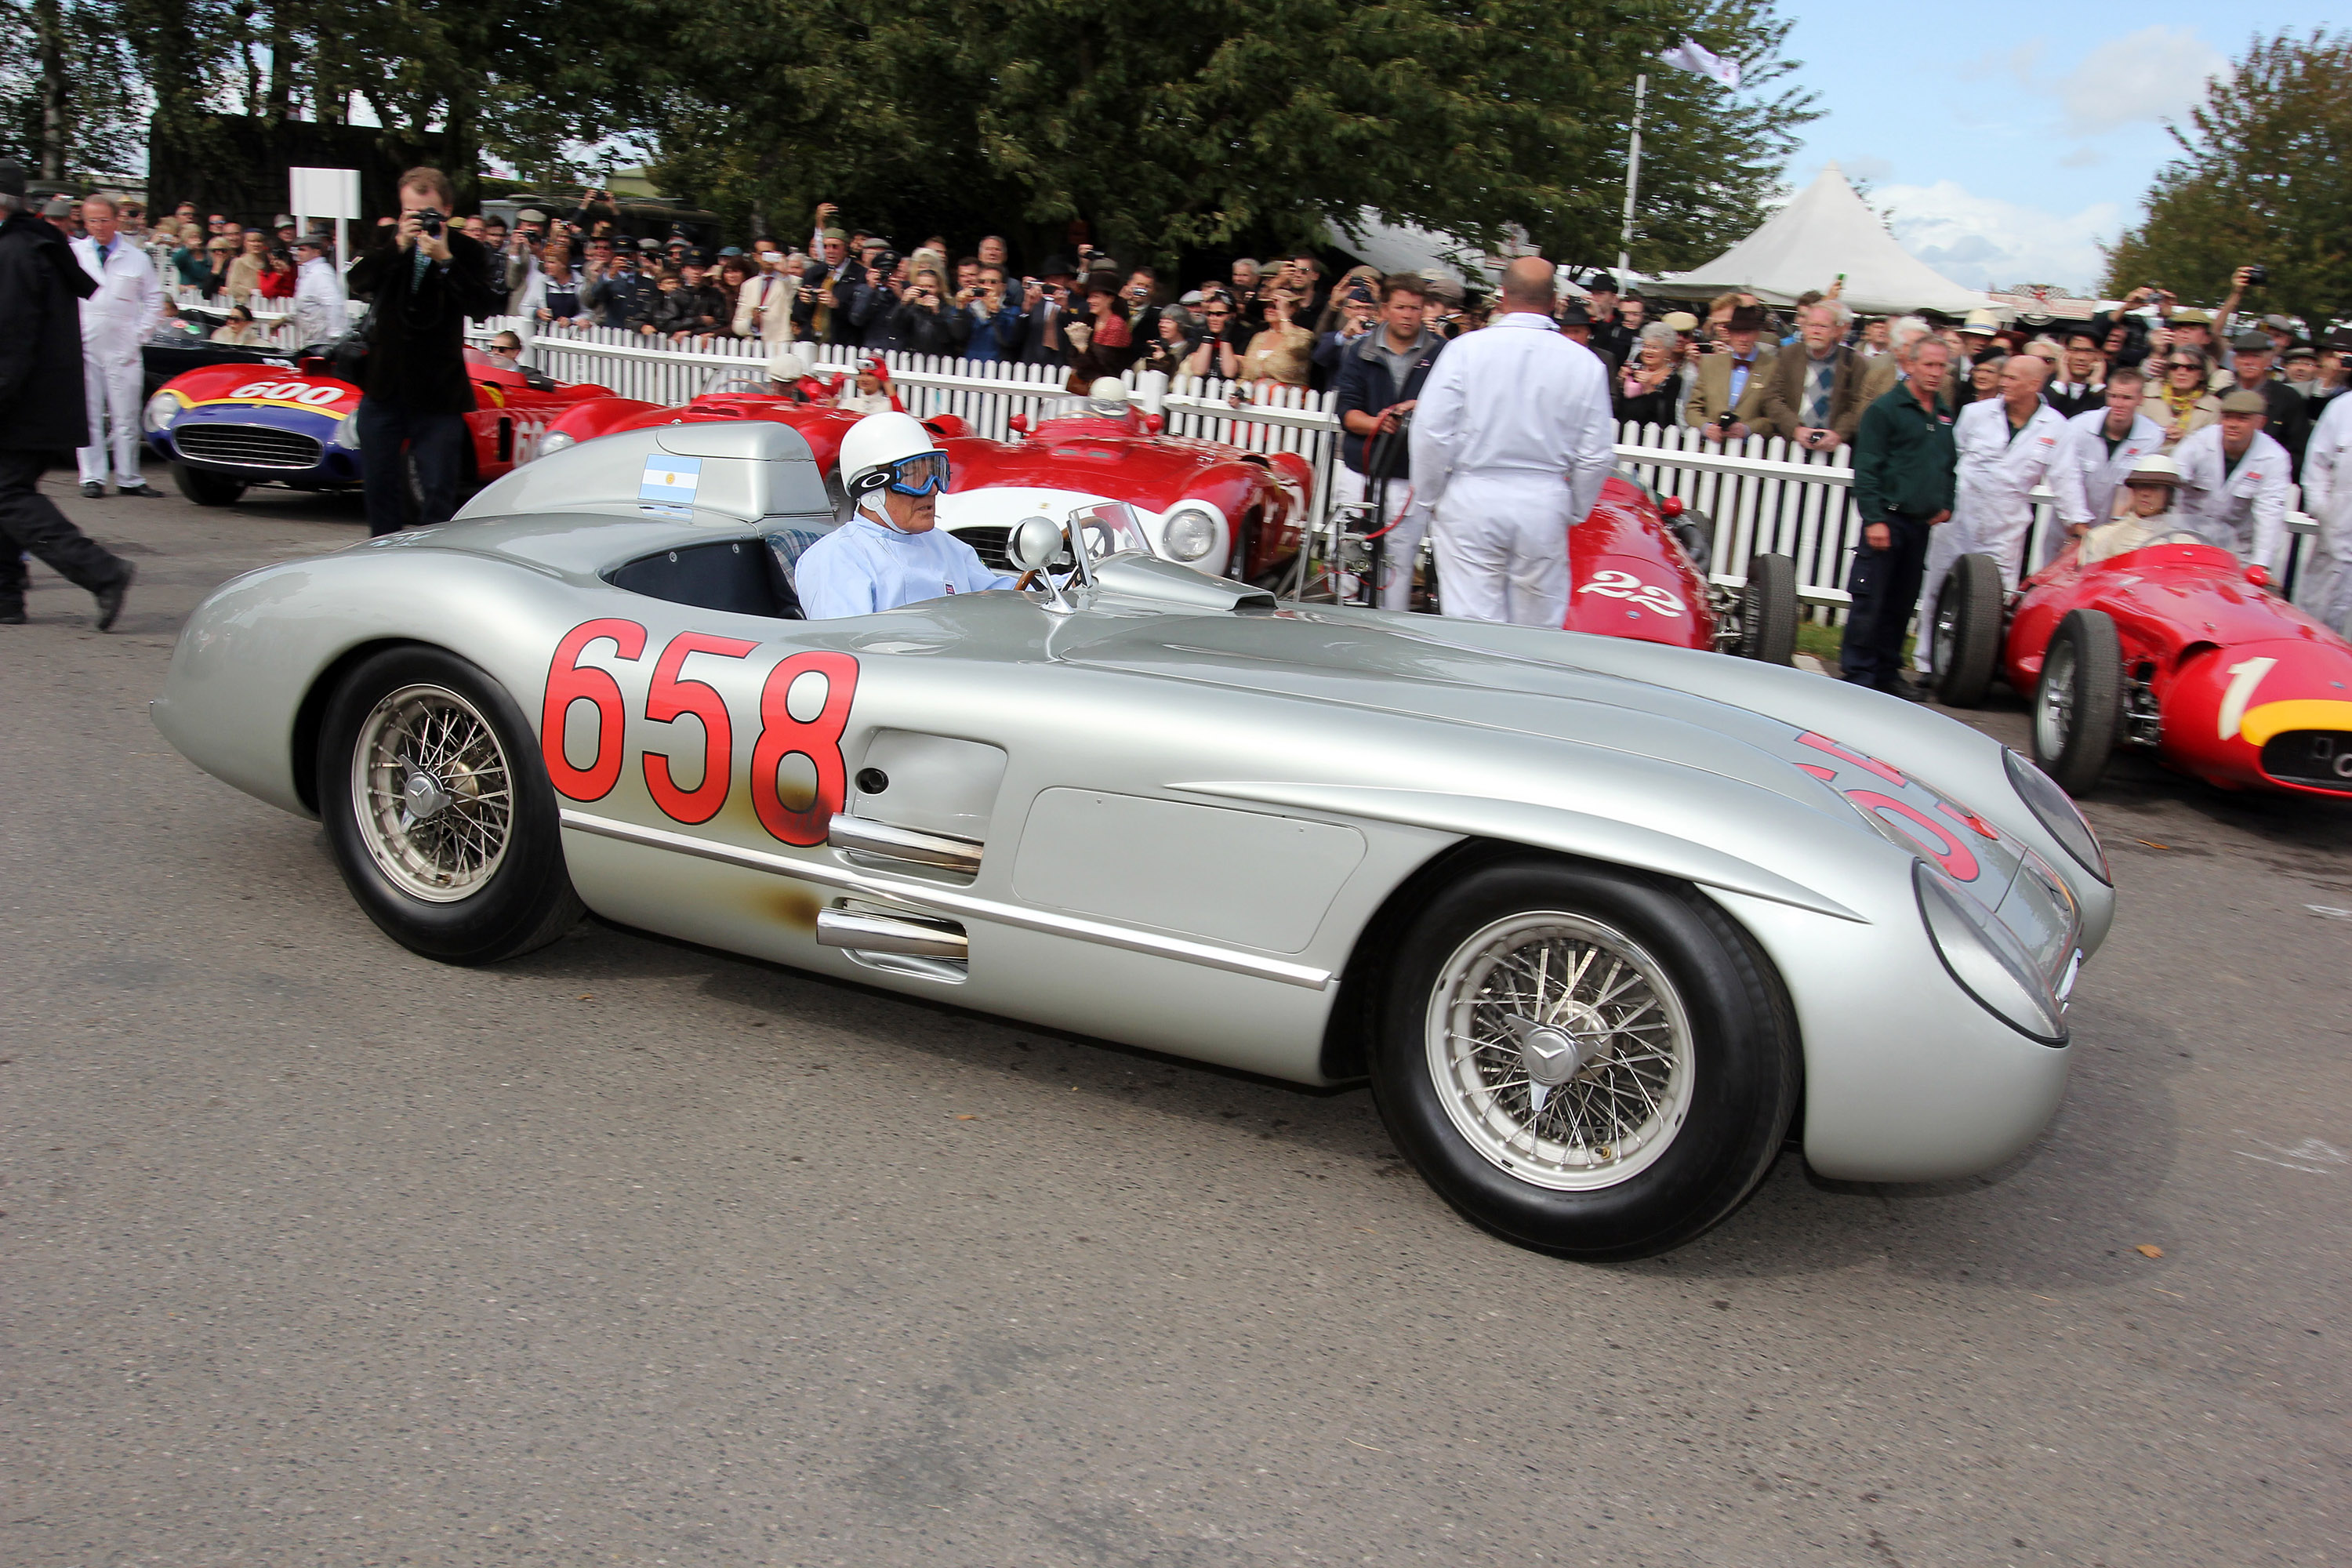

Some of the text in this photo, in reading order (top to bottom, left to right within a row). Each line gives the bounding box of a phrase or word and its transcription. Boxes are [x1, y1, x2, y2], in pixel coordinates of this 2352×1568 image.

[229, 381, 345, 405] 600
[1577, 570, 1687, 618] 22
[2217, 656, 2279, 741] 1
[540, 617, 861, 848] 658
